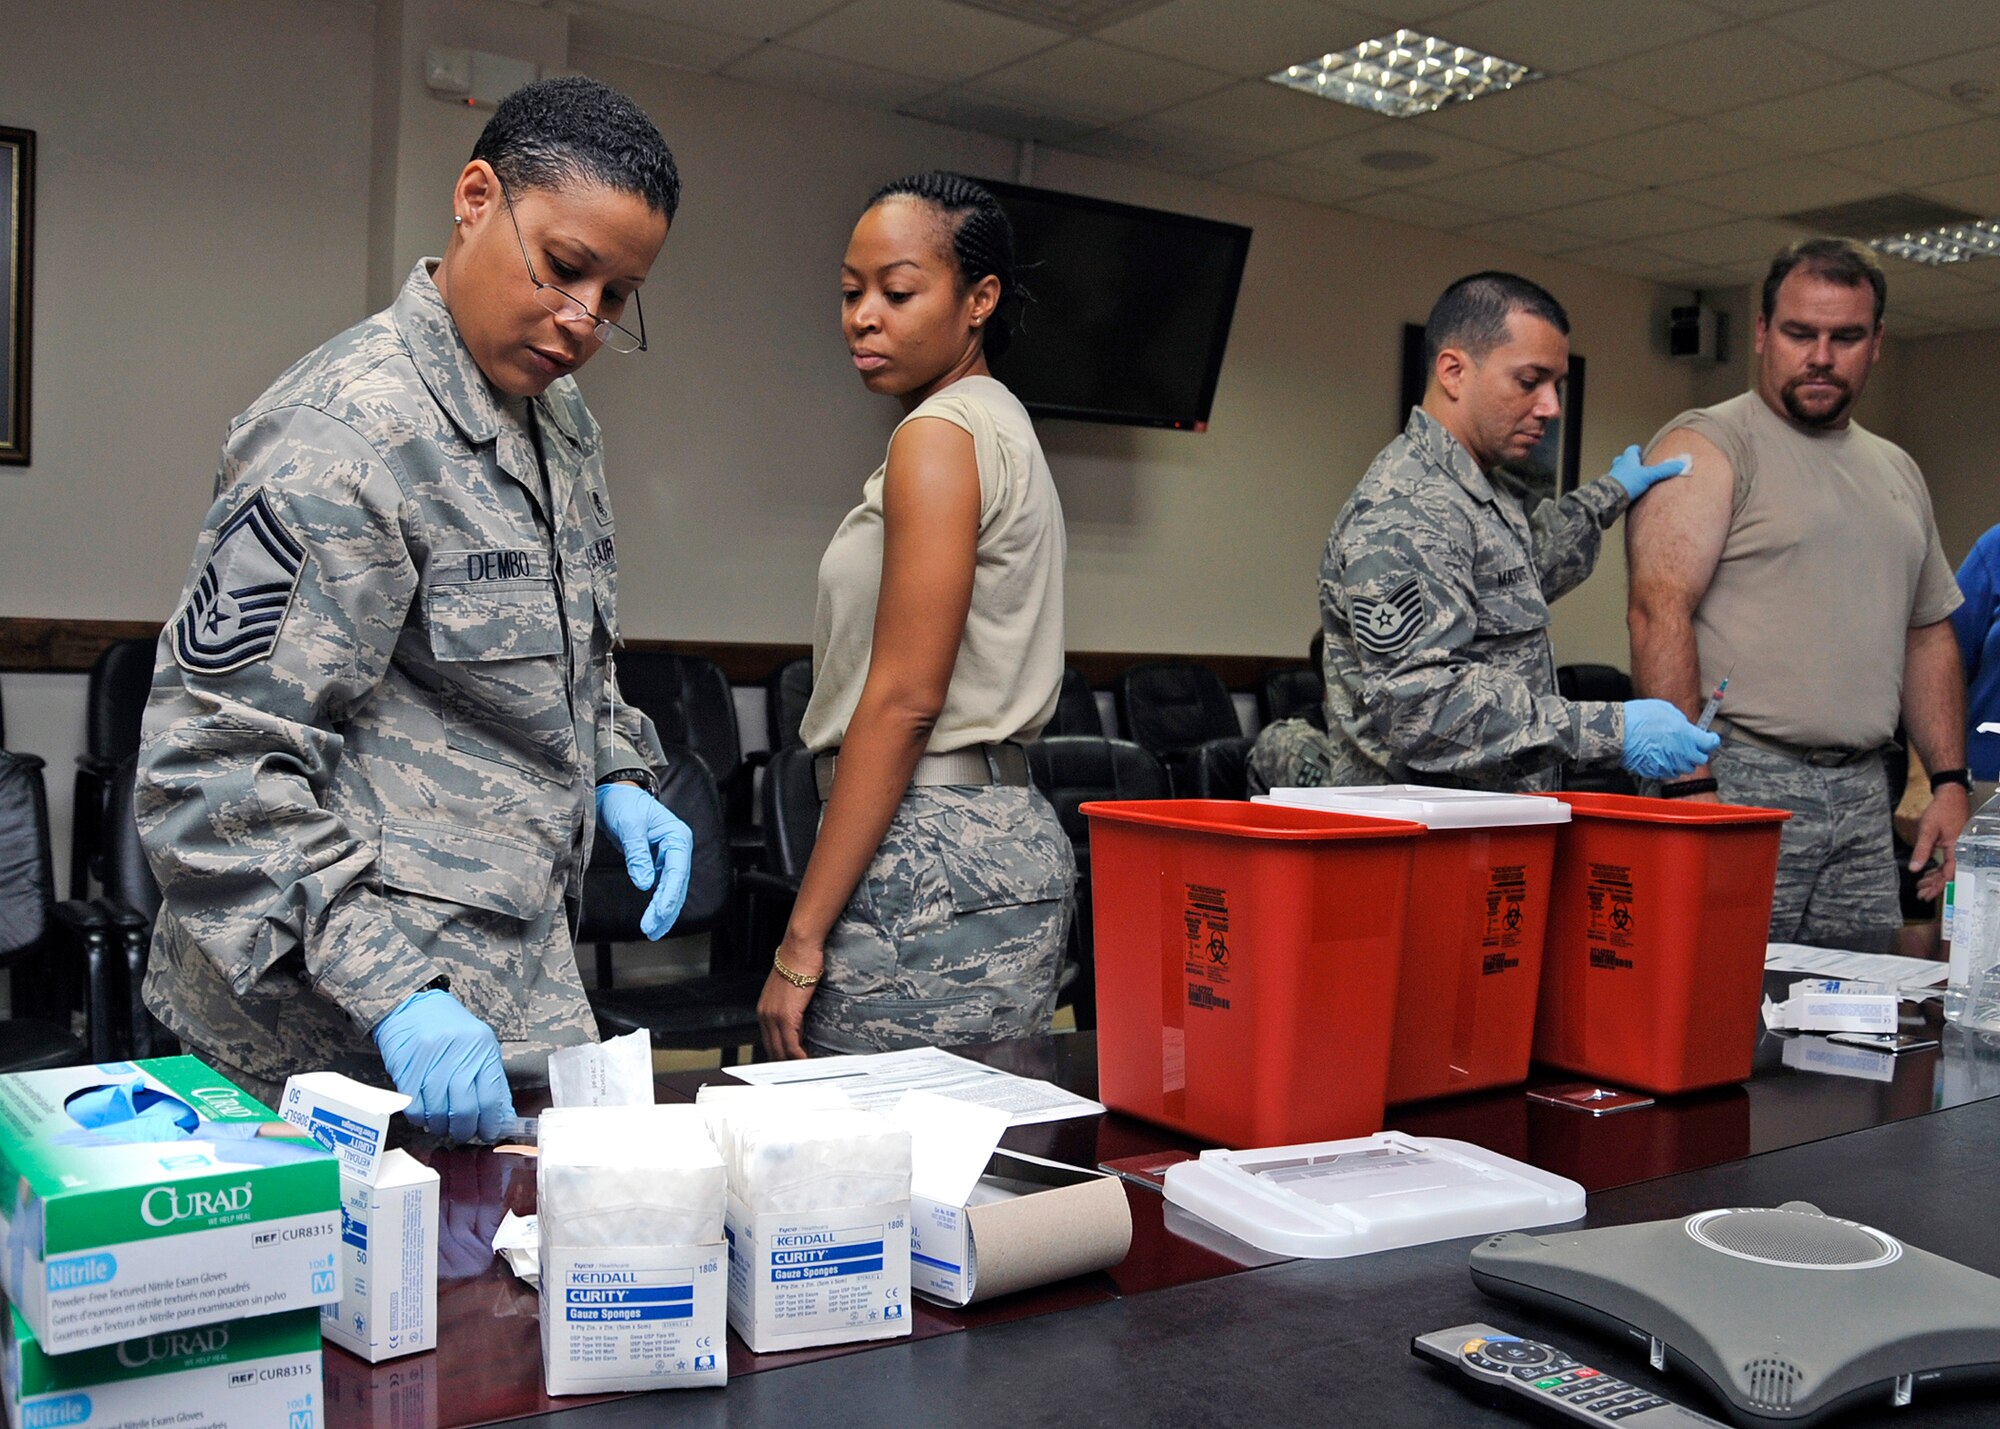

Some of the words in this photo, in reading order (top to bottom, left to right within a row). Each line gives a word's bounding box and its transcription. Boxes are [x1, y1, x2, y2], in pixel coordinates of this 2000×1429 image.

[467, 552, 530, 581] DEMBO
[289, 1088, 301, 1104] 50
[283, 1108, 309, 1127] 3065LF
[349, 1137, 374, 1154] CURITY
[344, 1149, 371, 1168] KENDALL
[141, 1183, 252, 1227] CURAD
[208, 1218, 219, 1226] WE
[219, 1215, 235, 1224] HELP
[235, 1213, 251, 1222] HEAL
[888, 1219, 904, 1230] 1806
[255, 1233, 277, 1245] REF
[282, 1224, 334, 1241] CUR8315
[777, 1233, 835, 1247] KENDALL
[356, 1251, 367, 1265] 50
[775, 1250, 825, 1264] CURITY
[50, 1258, 108, 1288] Nitrile
[309, 1261, 325, 1270] 100
[699, 1263, 718, 1274] 1806
[775, 1269, 801, 1280] Gauze
[803, 1266, 838, 1277] Sponges
[110, 1283, 146, 1297] Textured
[148, 1280, 174, 1292] Nitrile
[176, 1277, 199, 1289] Exam
[200, 1270, 228, 1283] Gloves
[314, 1272, 333, 1293] M
[572, 1272, 637, 1284] KENDALL
[125, 1305, 135, 1313] en
[137, 1298, 161, 1311] nitrile
[164, 1292, 198, 1306] texturés
[200, 1289, 216, 1298] non
[217, 1283, 251, 1298] poudrés
[570, 1290, 626, 1303] CURITY
[91, 1325, 101, 1334] de
[104, 1320, 135, 1332] Textura
[138, 1316, 147, 1325] de
[150, 1310, 175, 1322] Nitrile
[177, 1308, 195, 1320] para
[197, 1298, 250, 1314] examinacion
[251, 1296, 263, 1305] sin
[264, 1291, 287, 1305] polvo
[570, 1308, 599, 1319] Gauze
[601, 1308, 641, 1321] Sponges
[116, 1327, 229, 1368] CURAD
[184, 1358, 195, 1367] WE
[195, 1356, 210, 1365] HELP
[212, 1354, 228, 1362] HEAL
[231, 1373, 254, 1384] REF
[259, 1364, 312, 1381] CUR8315
[287, 1401, 304, 1409] 100
[25, 1401, 82, 1429] Nitrile
[152, 1413, 175, 1427] Exam
[177, 1411, 204, 1424] Gloves
[292, 1412, 311, 1429] M
